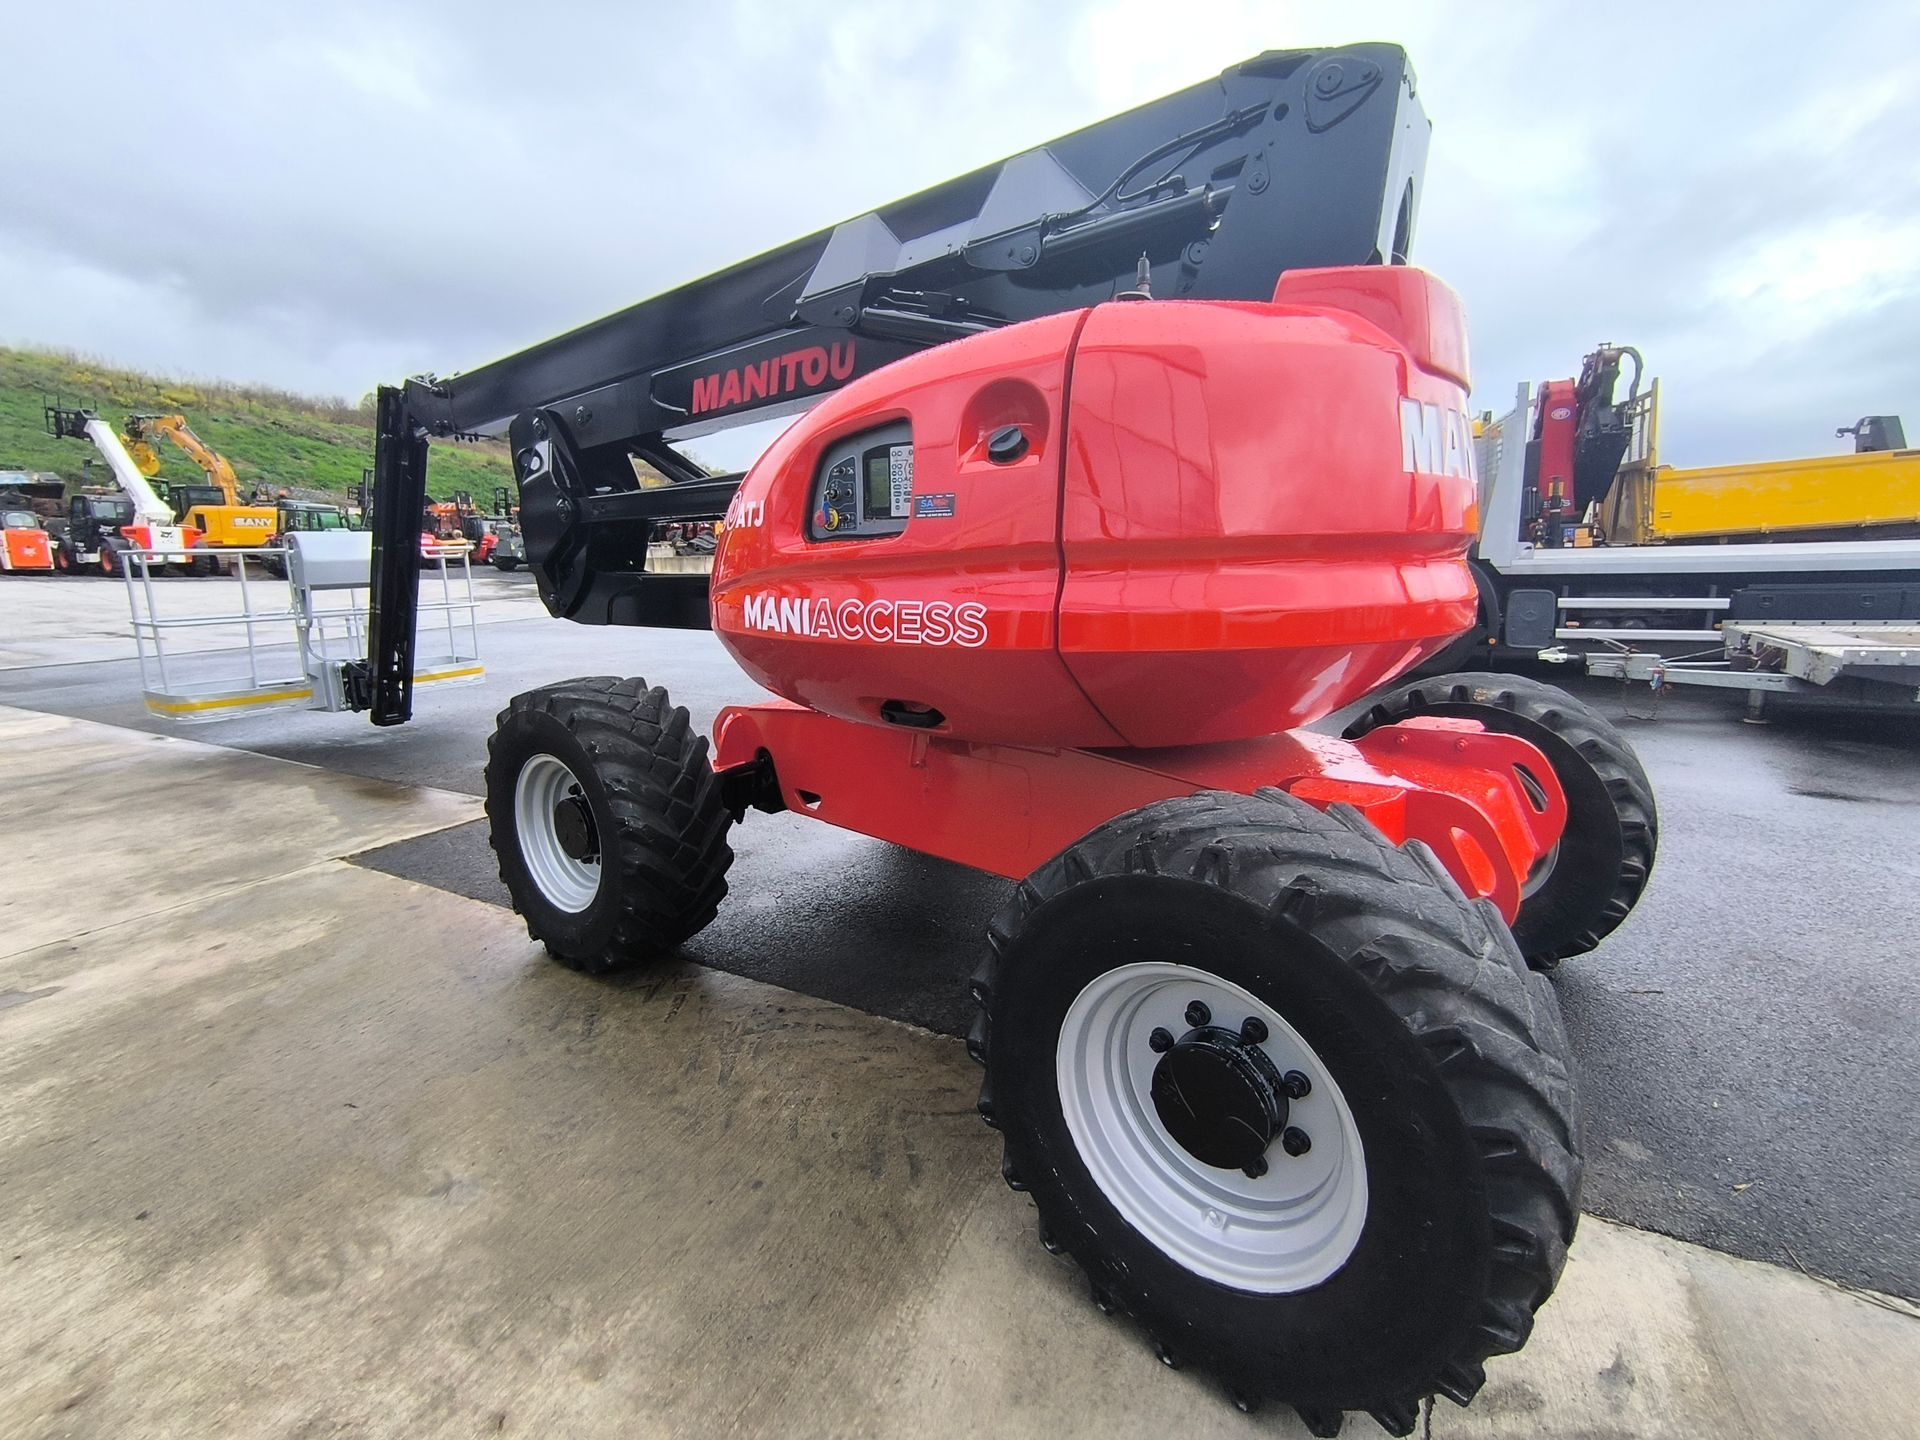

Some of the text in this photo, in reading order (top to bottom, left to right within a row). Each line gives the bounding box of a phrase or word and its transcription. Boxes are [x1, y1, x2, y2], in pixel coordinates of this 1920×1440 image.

[692, 339, 856, 415] MANITOU
[233, 517, 273, 527] SANY
[721, 491, 765, 534] 0ATJ
[743, 594, 988, 648] MANIACCESS
